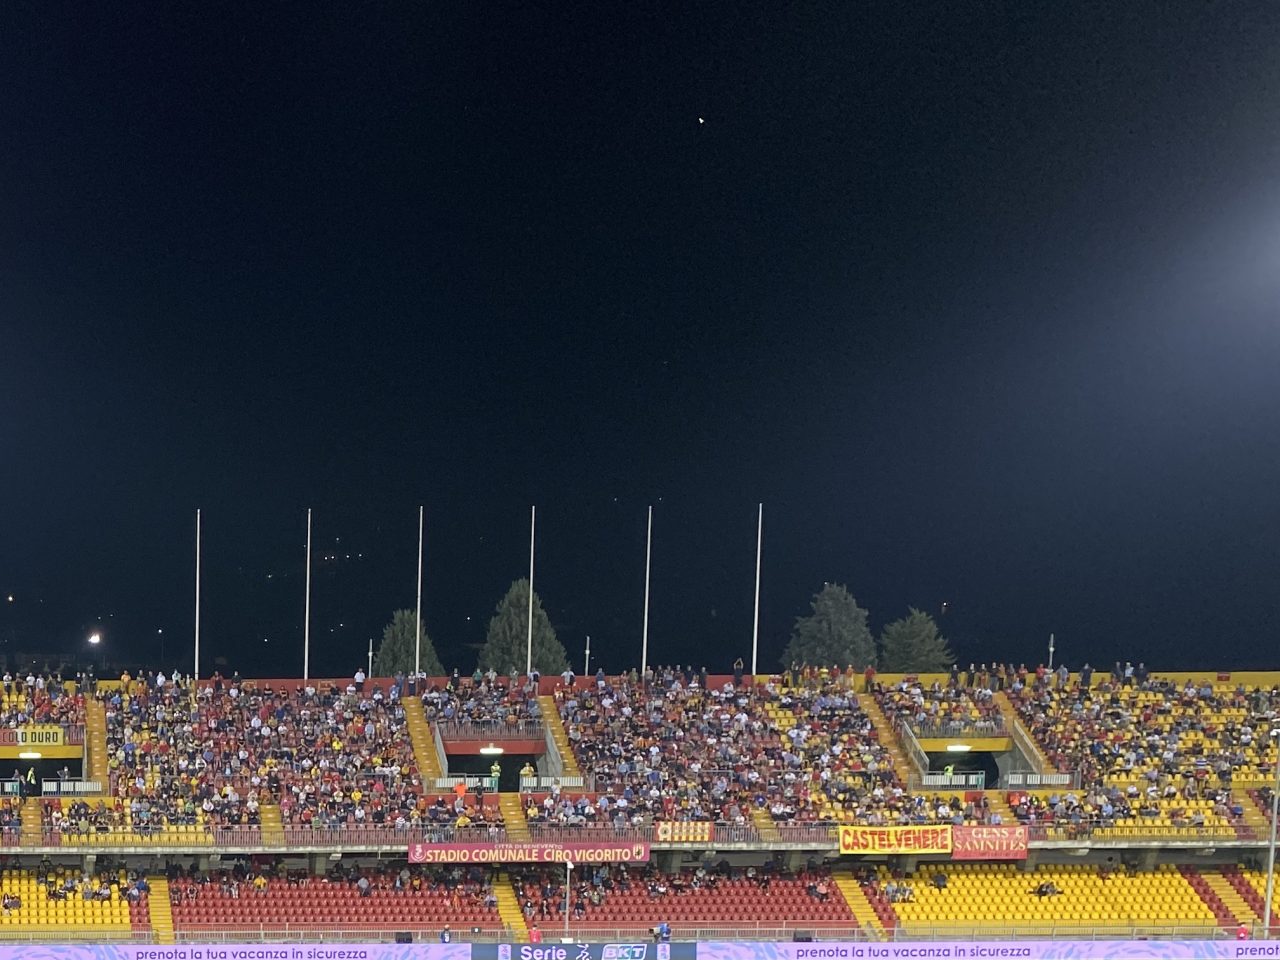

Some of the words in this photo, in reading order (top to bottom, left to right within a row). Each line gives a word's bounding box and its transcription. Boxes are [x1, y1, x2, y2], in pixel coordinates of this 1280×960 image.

[31, 731, 58, 743] DURO
[971, 827, 1009, 839] GENS
[841, 828, 949, 851] CASTELVENERE
[954, 840, 1026, 852] SAMNITES
[426, 849, 470, 862] STADIO
[472, 849, 539, 862] COMUNALE
[543, 849, 572, 862] CIRO
[574, 848, 631, 862] VIGORITO
[190, 949, 202, 959] la
[207, 949, 227, 959] tua
[231, 950, 288, 959] vacanza
[292, 948, 303, 959] in
[307, 948, 367, 959] sicurezza
[520, 945, 567, 960] Serie
[603, 945, 644, 959] BKT
[796, 947, 848, 959] prenota
[852, 946, 864, 957] la
[869, 947, 889, 957] tua
[893, 949, 950, 957] vacanza
[955, 946, 965, 957] in
[970, 946, 1031, 957] sicurezza
